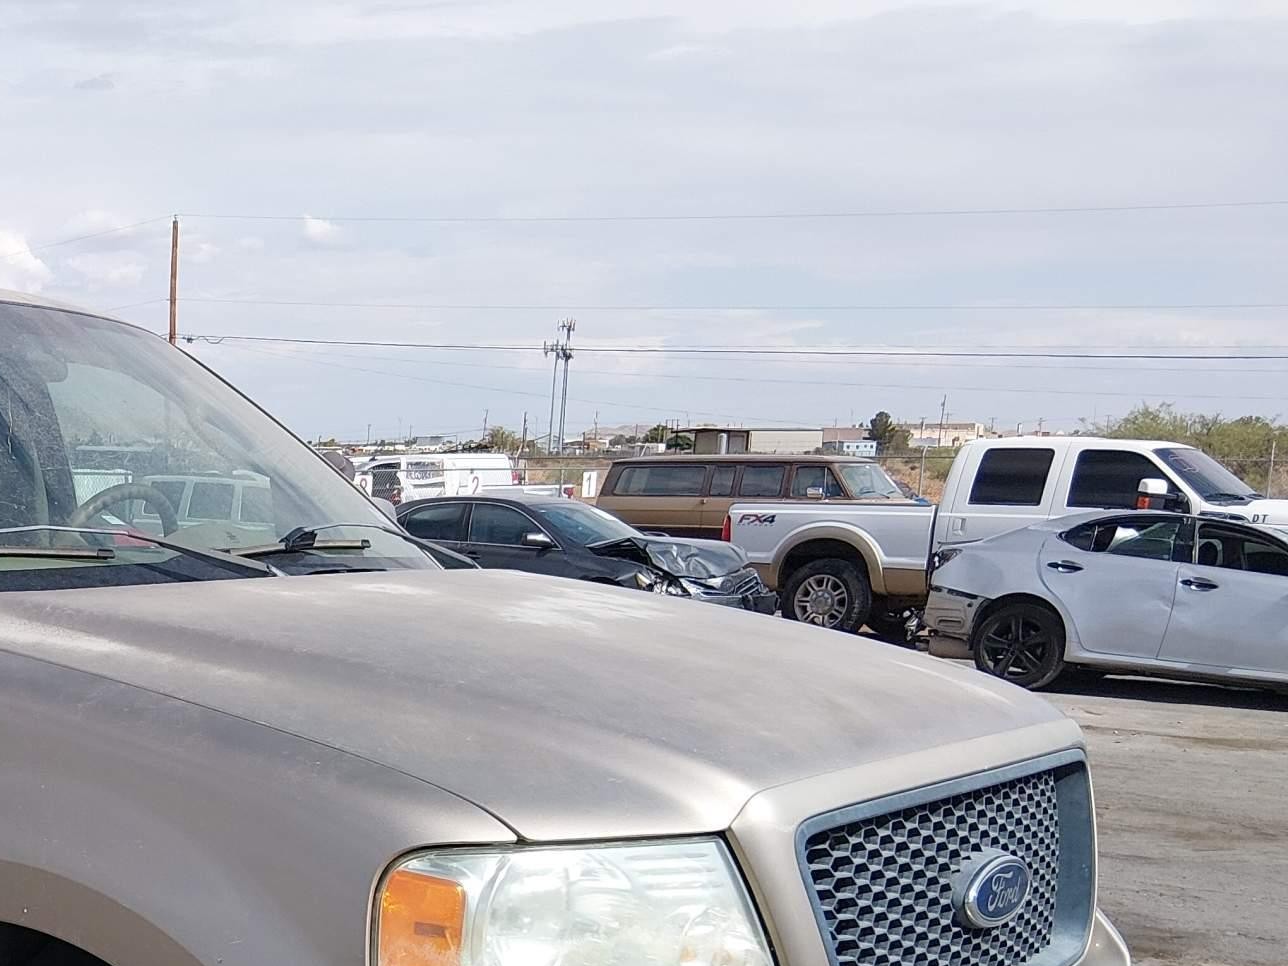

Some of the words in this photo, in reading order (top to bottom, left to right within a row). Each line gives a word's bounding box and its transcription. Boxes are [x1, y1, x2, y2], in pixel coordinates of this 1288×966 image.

[586, 473, 592, 496] 1
[738, 514, 776, 524] FX4
[988, 871, 1021, 912] Ford
